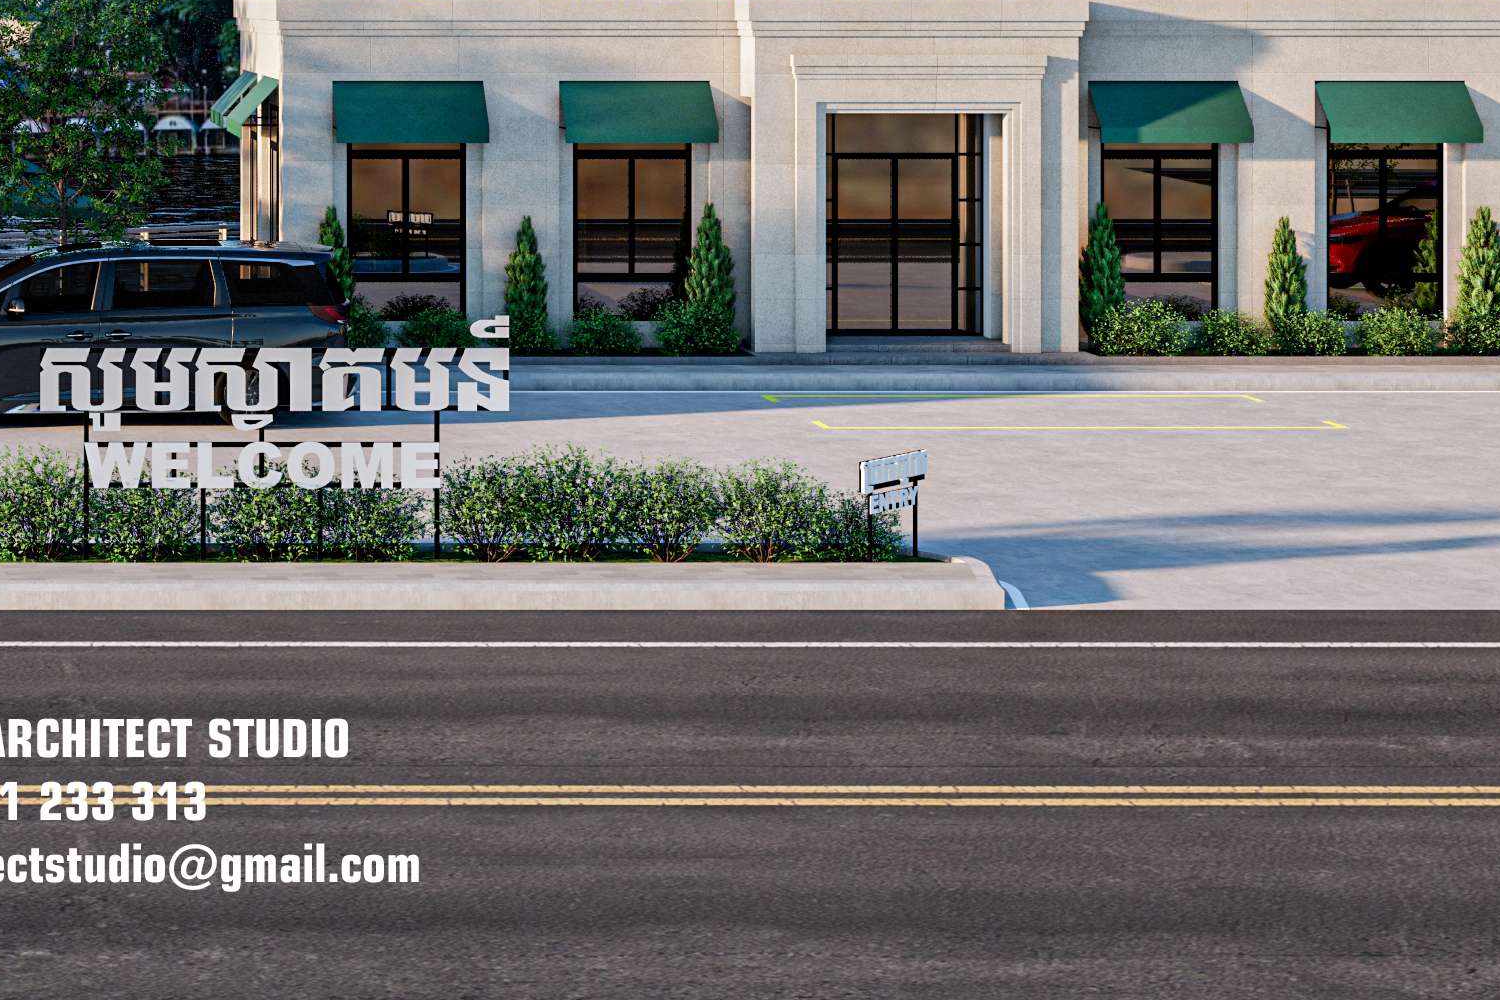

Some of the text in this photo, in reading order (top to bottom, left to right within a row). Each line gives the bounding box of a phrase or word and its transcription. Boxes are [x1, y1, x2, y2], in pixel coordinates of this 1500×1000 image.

[40, 315, 509, 431] សូមស្វាគមន៍
[84, 442, 440, 489] WELCOME
[869, 486, 918, 515] ENTRY
